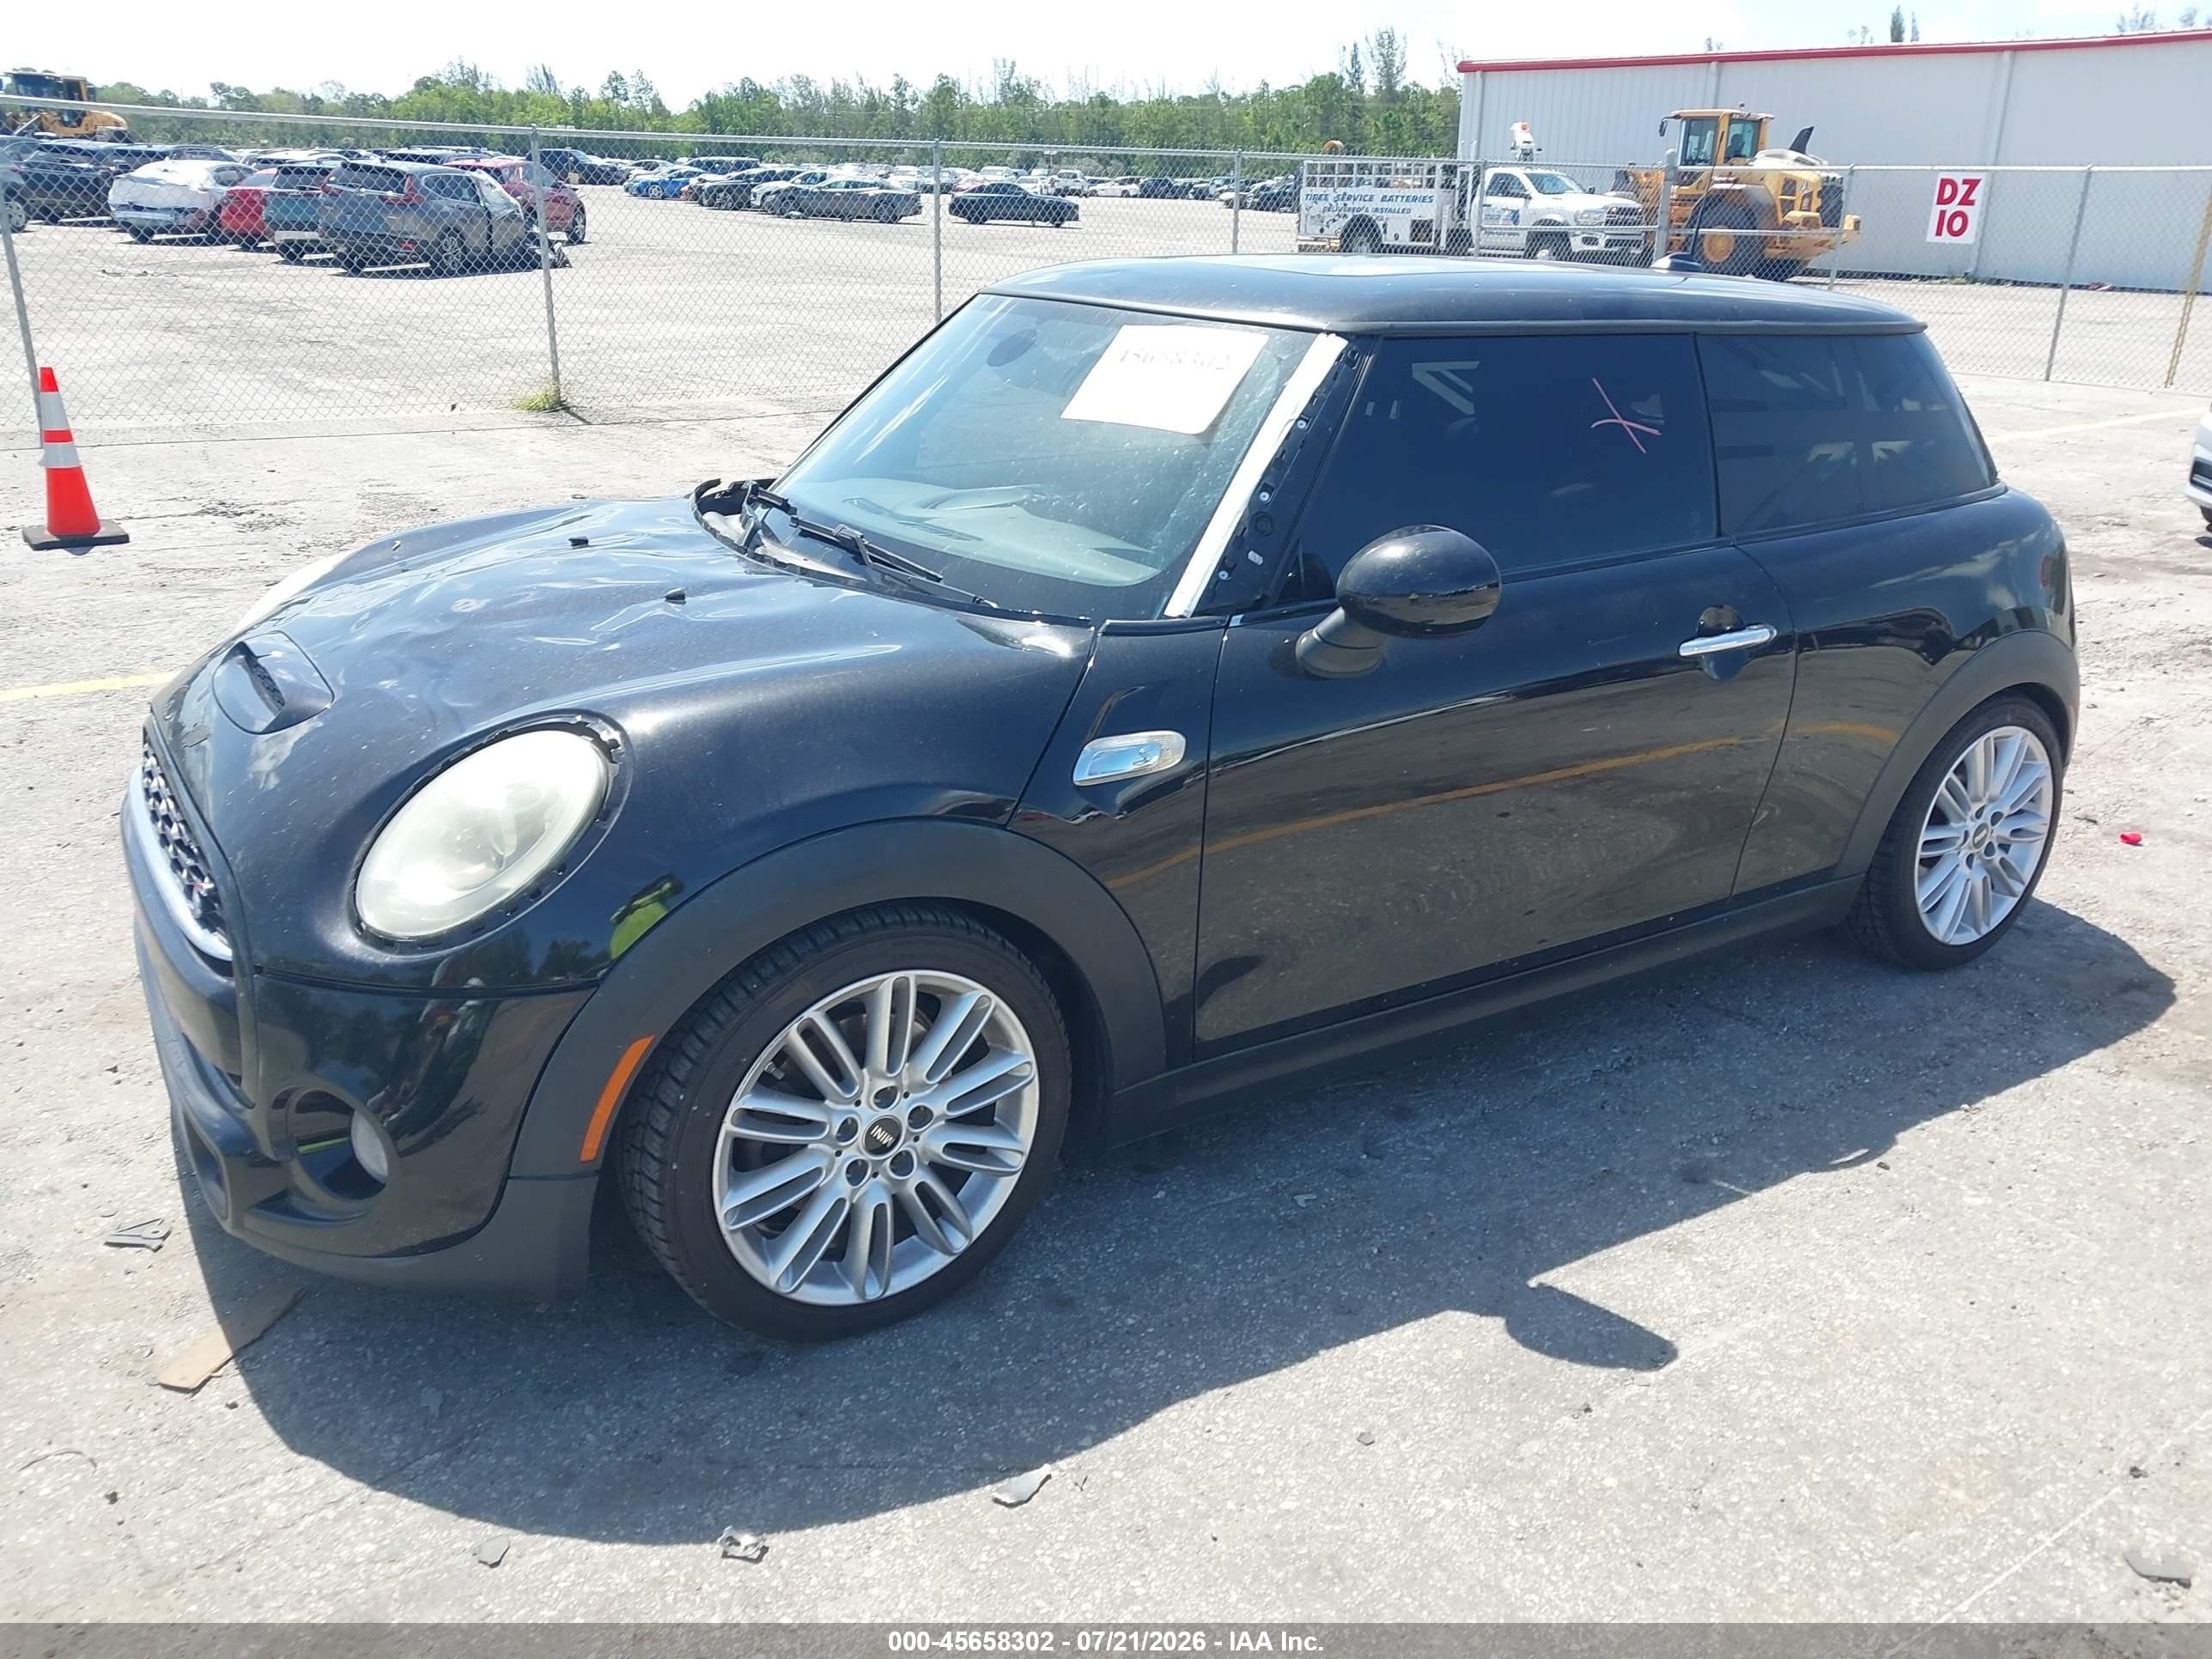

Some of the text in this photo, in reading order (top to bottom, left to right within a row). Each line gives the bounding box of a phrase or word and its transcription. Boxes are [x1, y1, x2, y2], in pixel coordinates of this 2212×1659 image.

[1304, 193, 1435, 204] TIRES SERVICE BATTERIES
[1936, 178, 1983, 206] DZ
[869, 1124, 896, 1148] MINI
